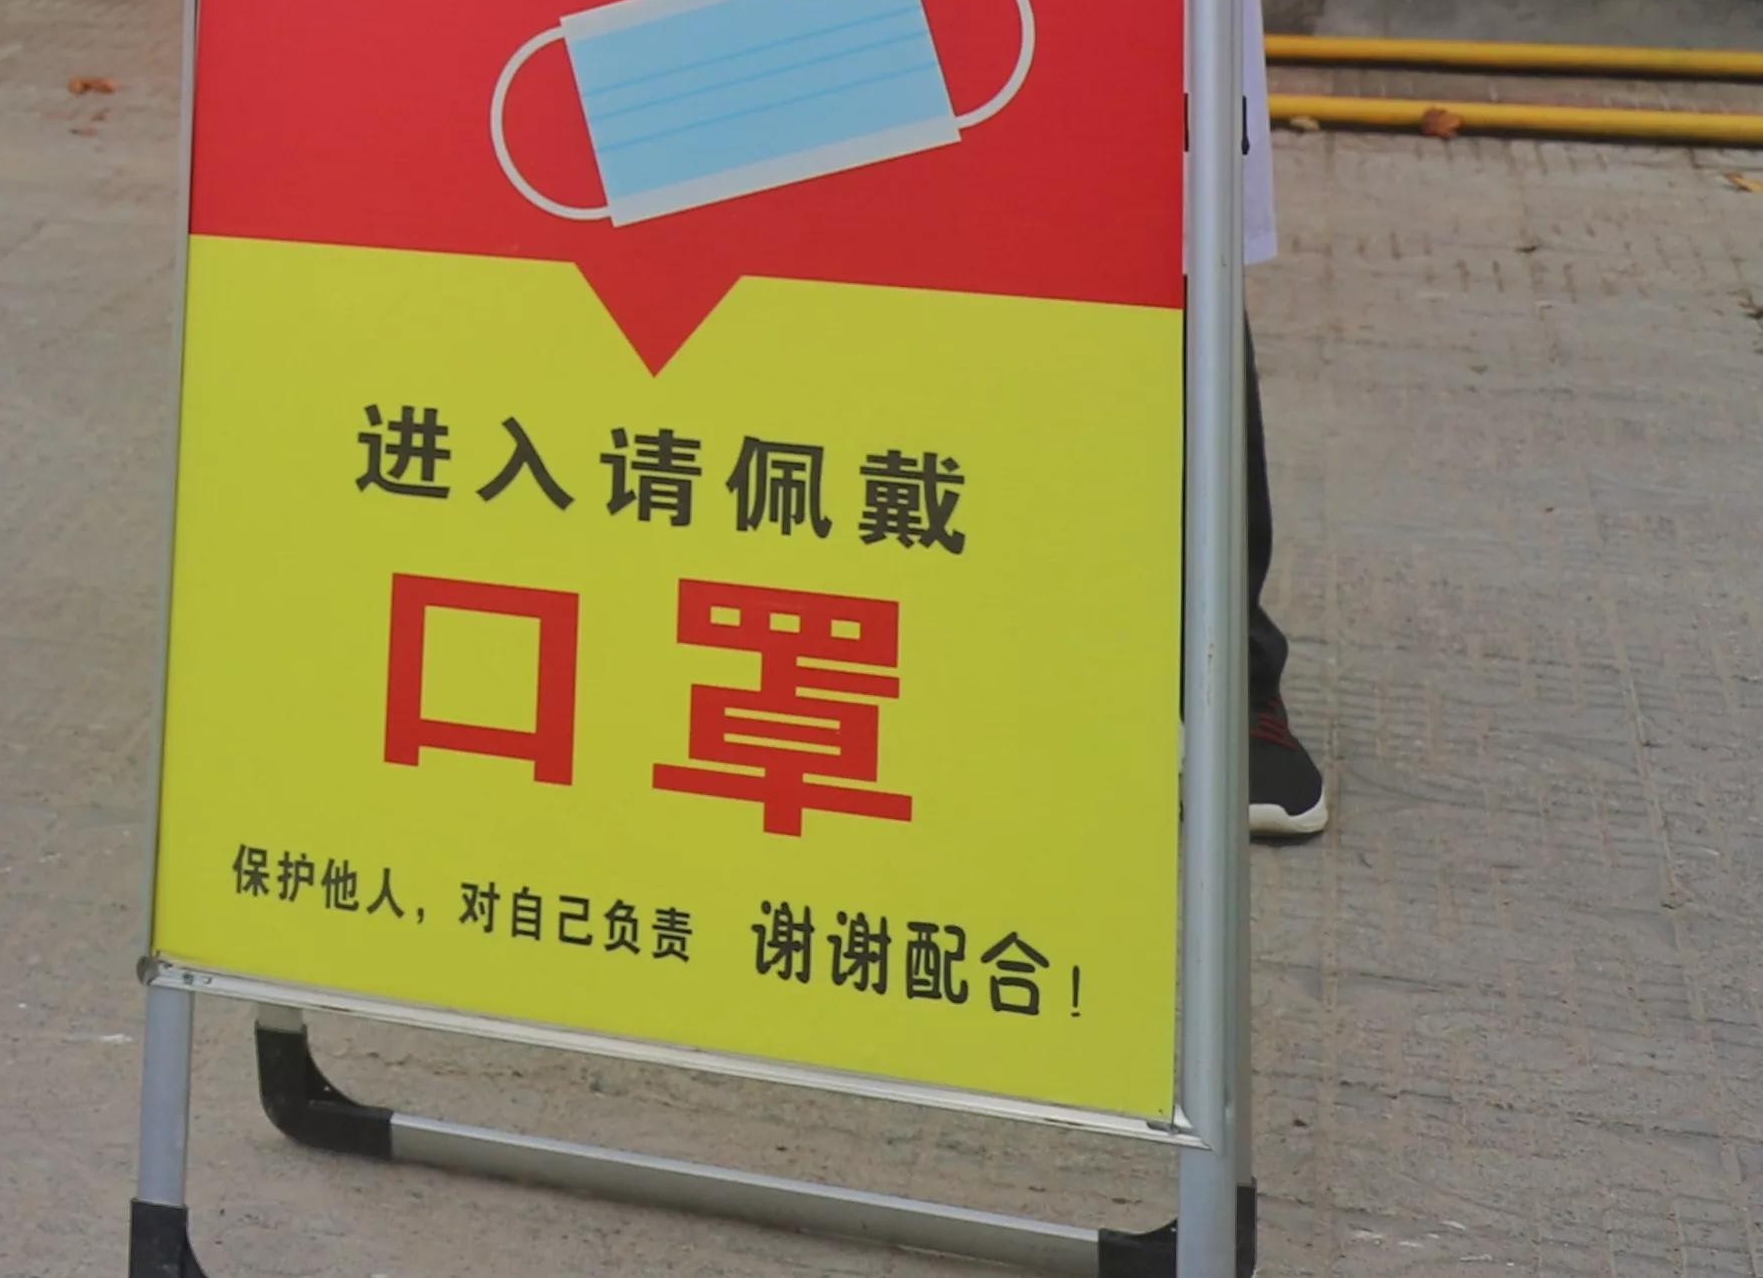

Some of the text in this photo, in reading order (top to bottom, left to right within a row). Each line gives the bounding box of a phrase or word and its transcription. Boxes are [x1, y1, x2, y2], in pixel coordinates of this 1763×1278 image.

[355, 404, 966, 555] 进入请佩戴
[384, 573, 912, 837] 口罩
[233, 844, 1080, 1018] 保护他人，对自己负责 谢谢配合！
